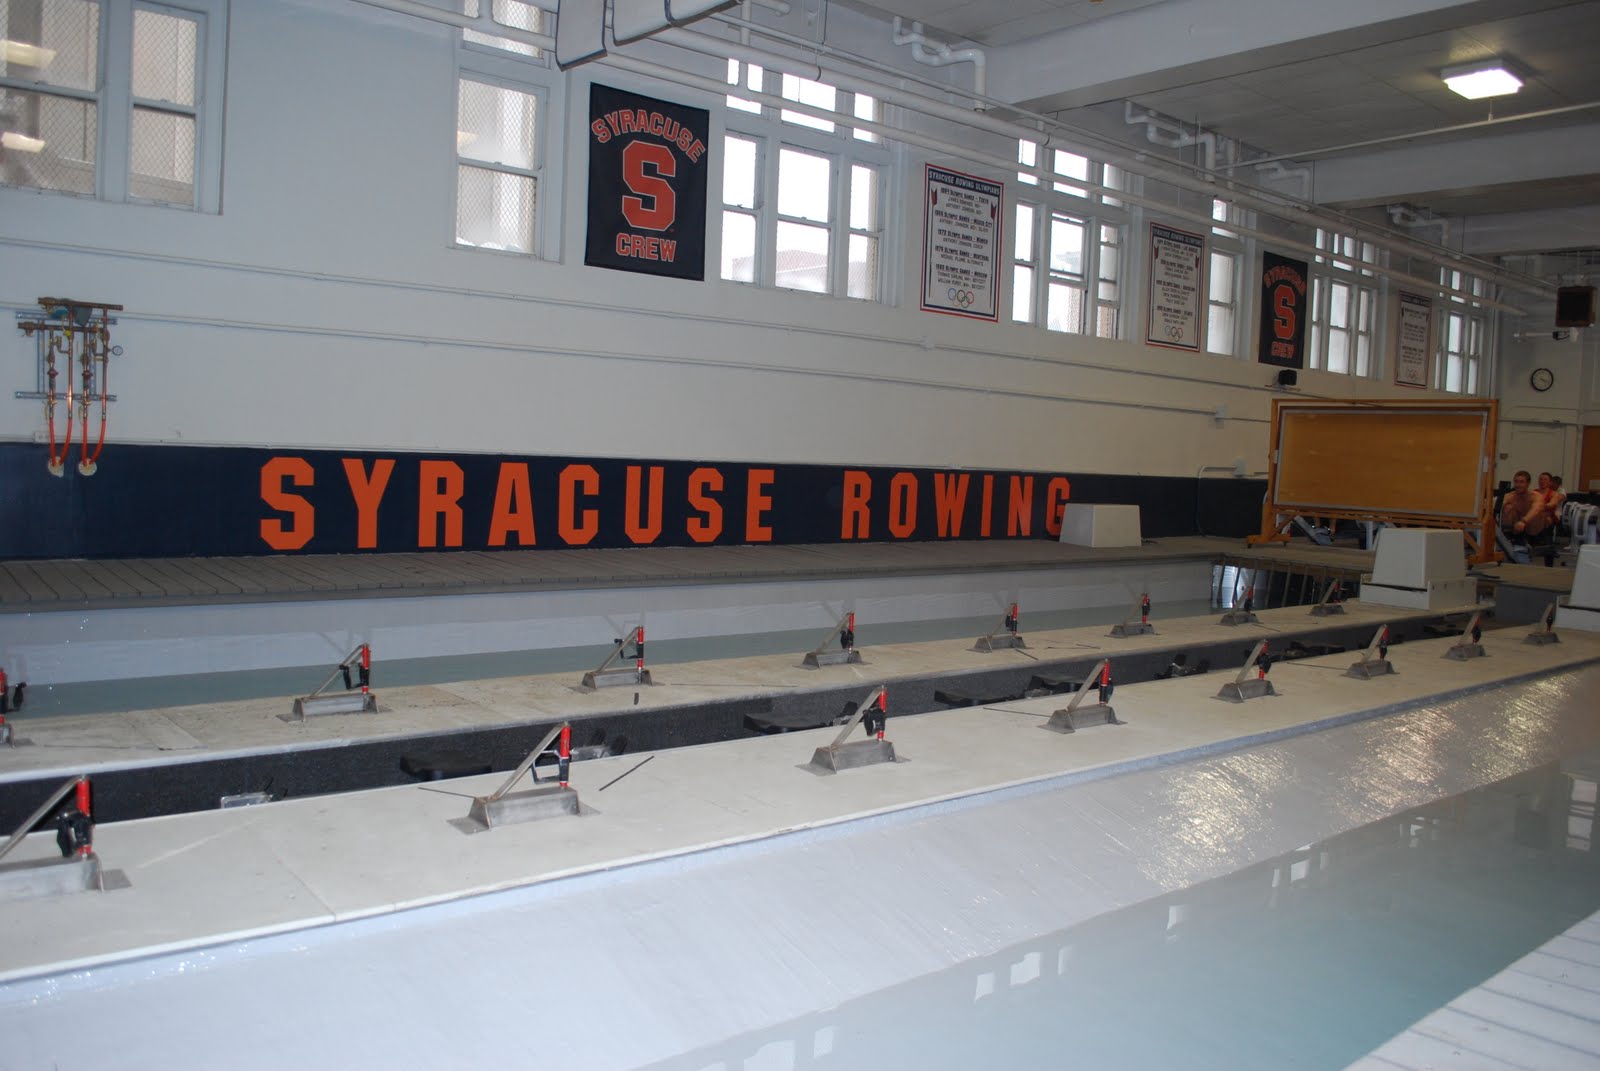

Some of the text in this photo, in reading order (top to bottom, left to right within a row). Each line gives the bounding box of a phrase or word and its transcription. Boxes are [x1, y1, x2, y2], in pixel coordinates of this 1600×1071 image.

[592, 109, 705, 163] SYRACUSE
[622, 140, 676, 231] S
[929, 171, 1000, 195] SYRACUSE ROWING OLYMPIANS
[616, 232, 676, 262] CREW
[1274, 284, 1296, 340] S
[260, 456, 1071, 550] SYRACUSE ROWING
